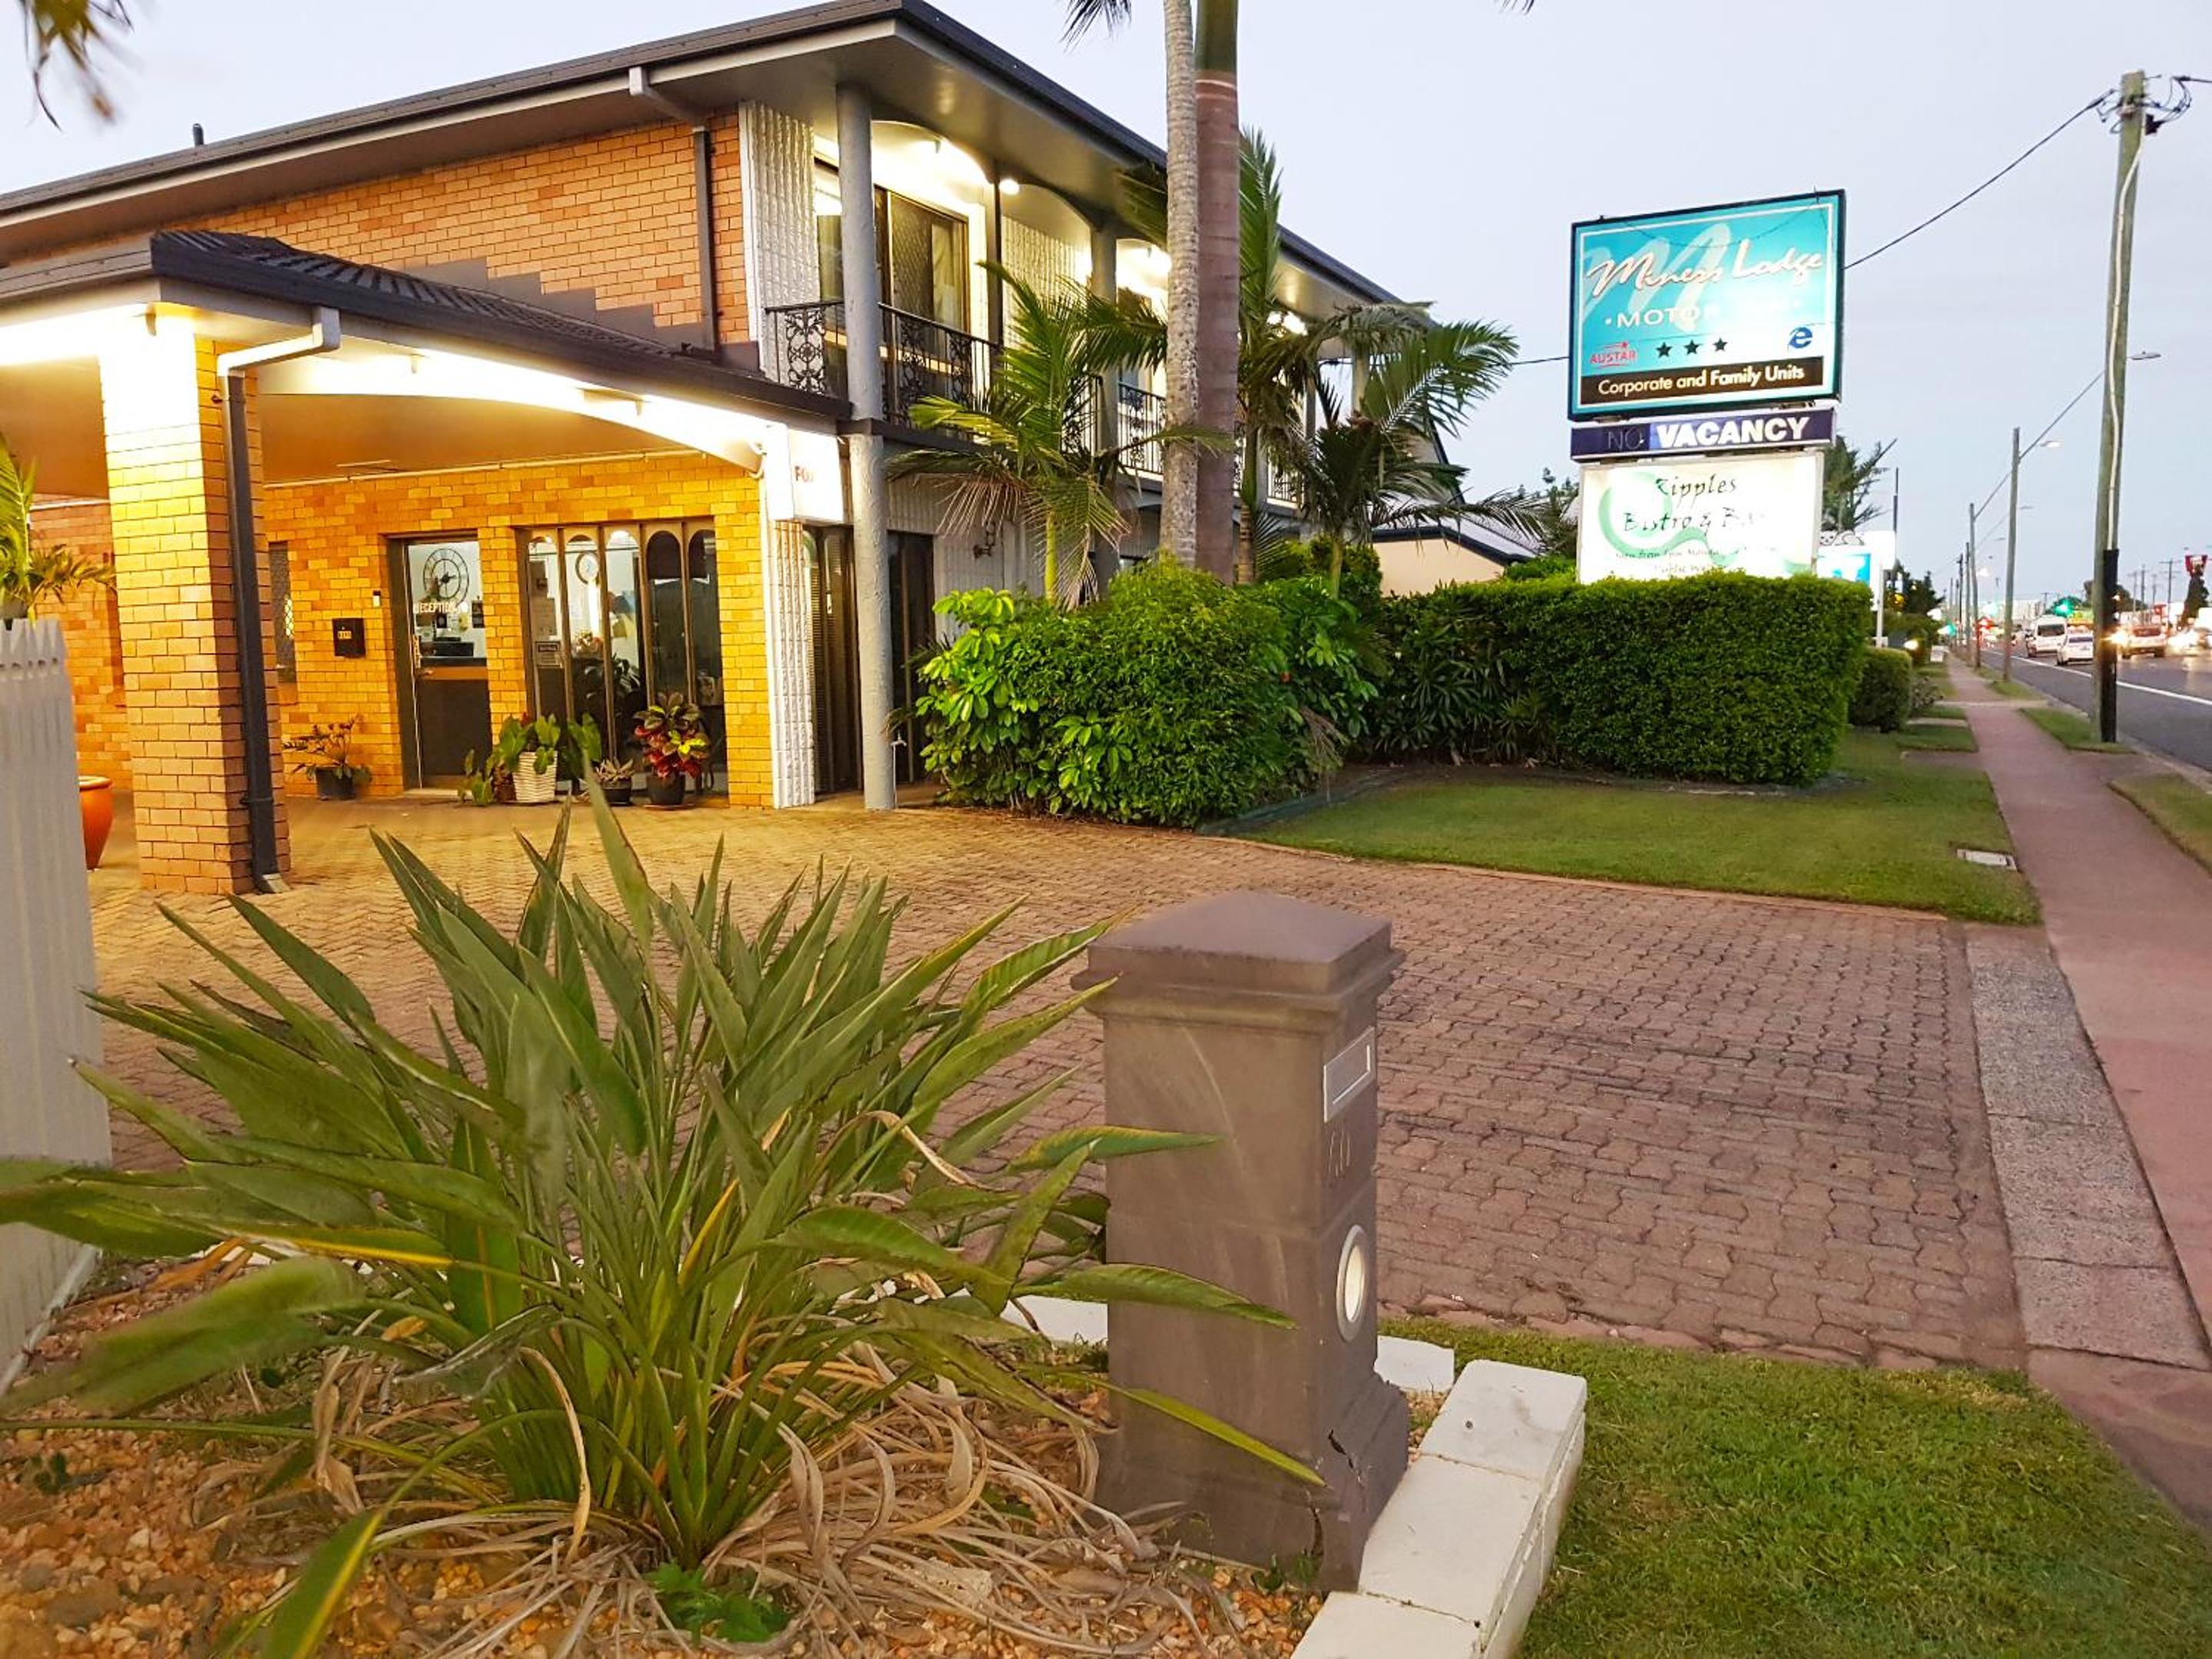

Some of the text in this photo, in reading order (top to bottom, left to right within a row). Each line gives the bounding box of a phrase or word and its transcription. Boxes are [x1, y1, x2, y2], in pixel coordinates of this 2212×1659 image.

[1589, 350, 1637, 364] AUSTAR
[1598, 364, 1804, 396] Corporate and Family Units
[1656, 417, 1810, 448] VACANCY
